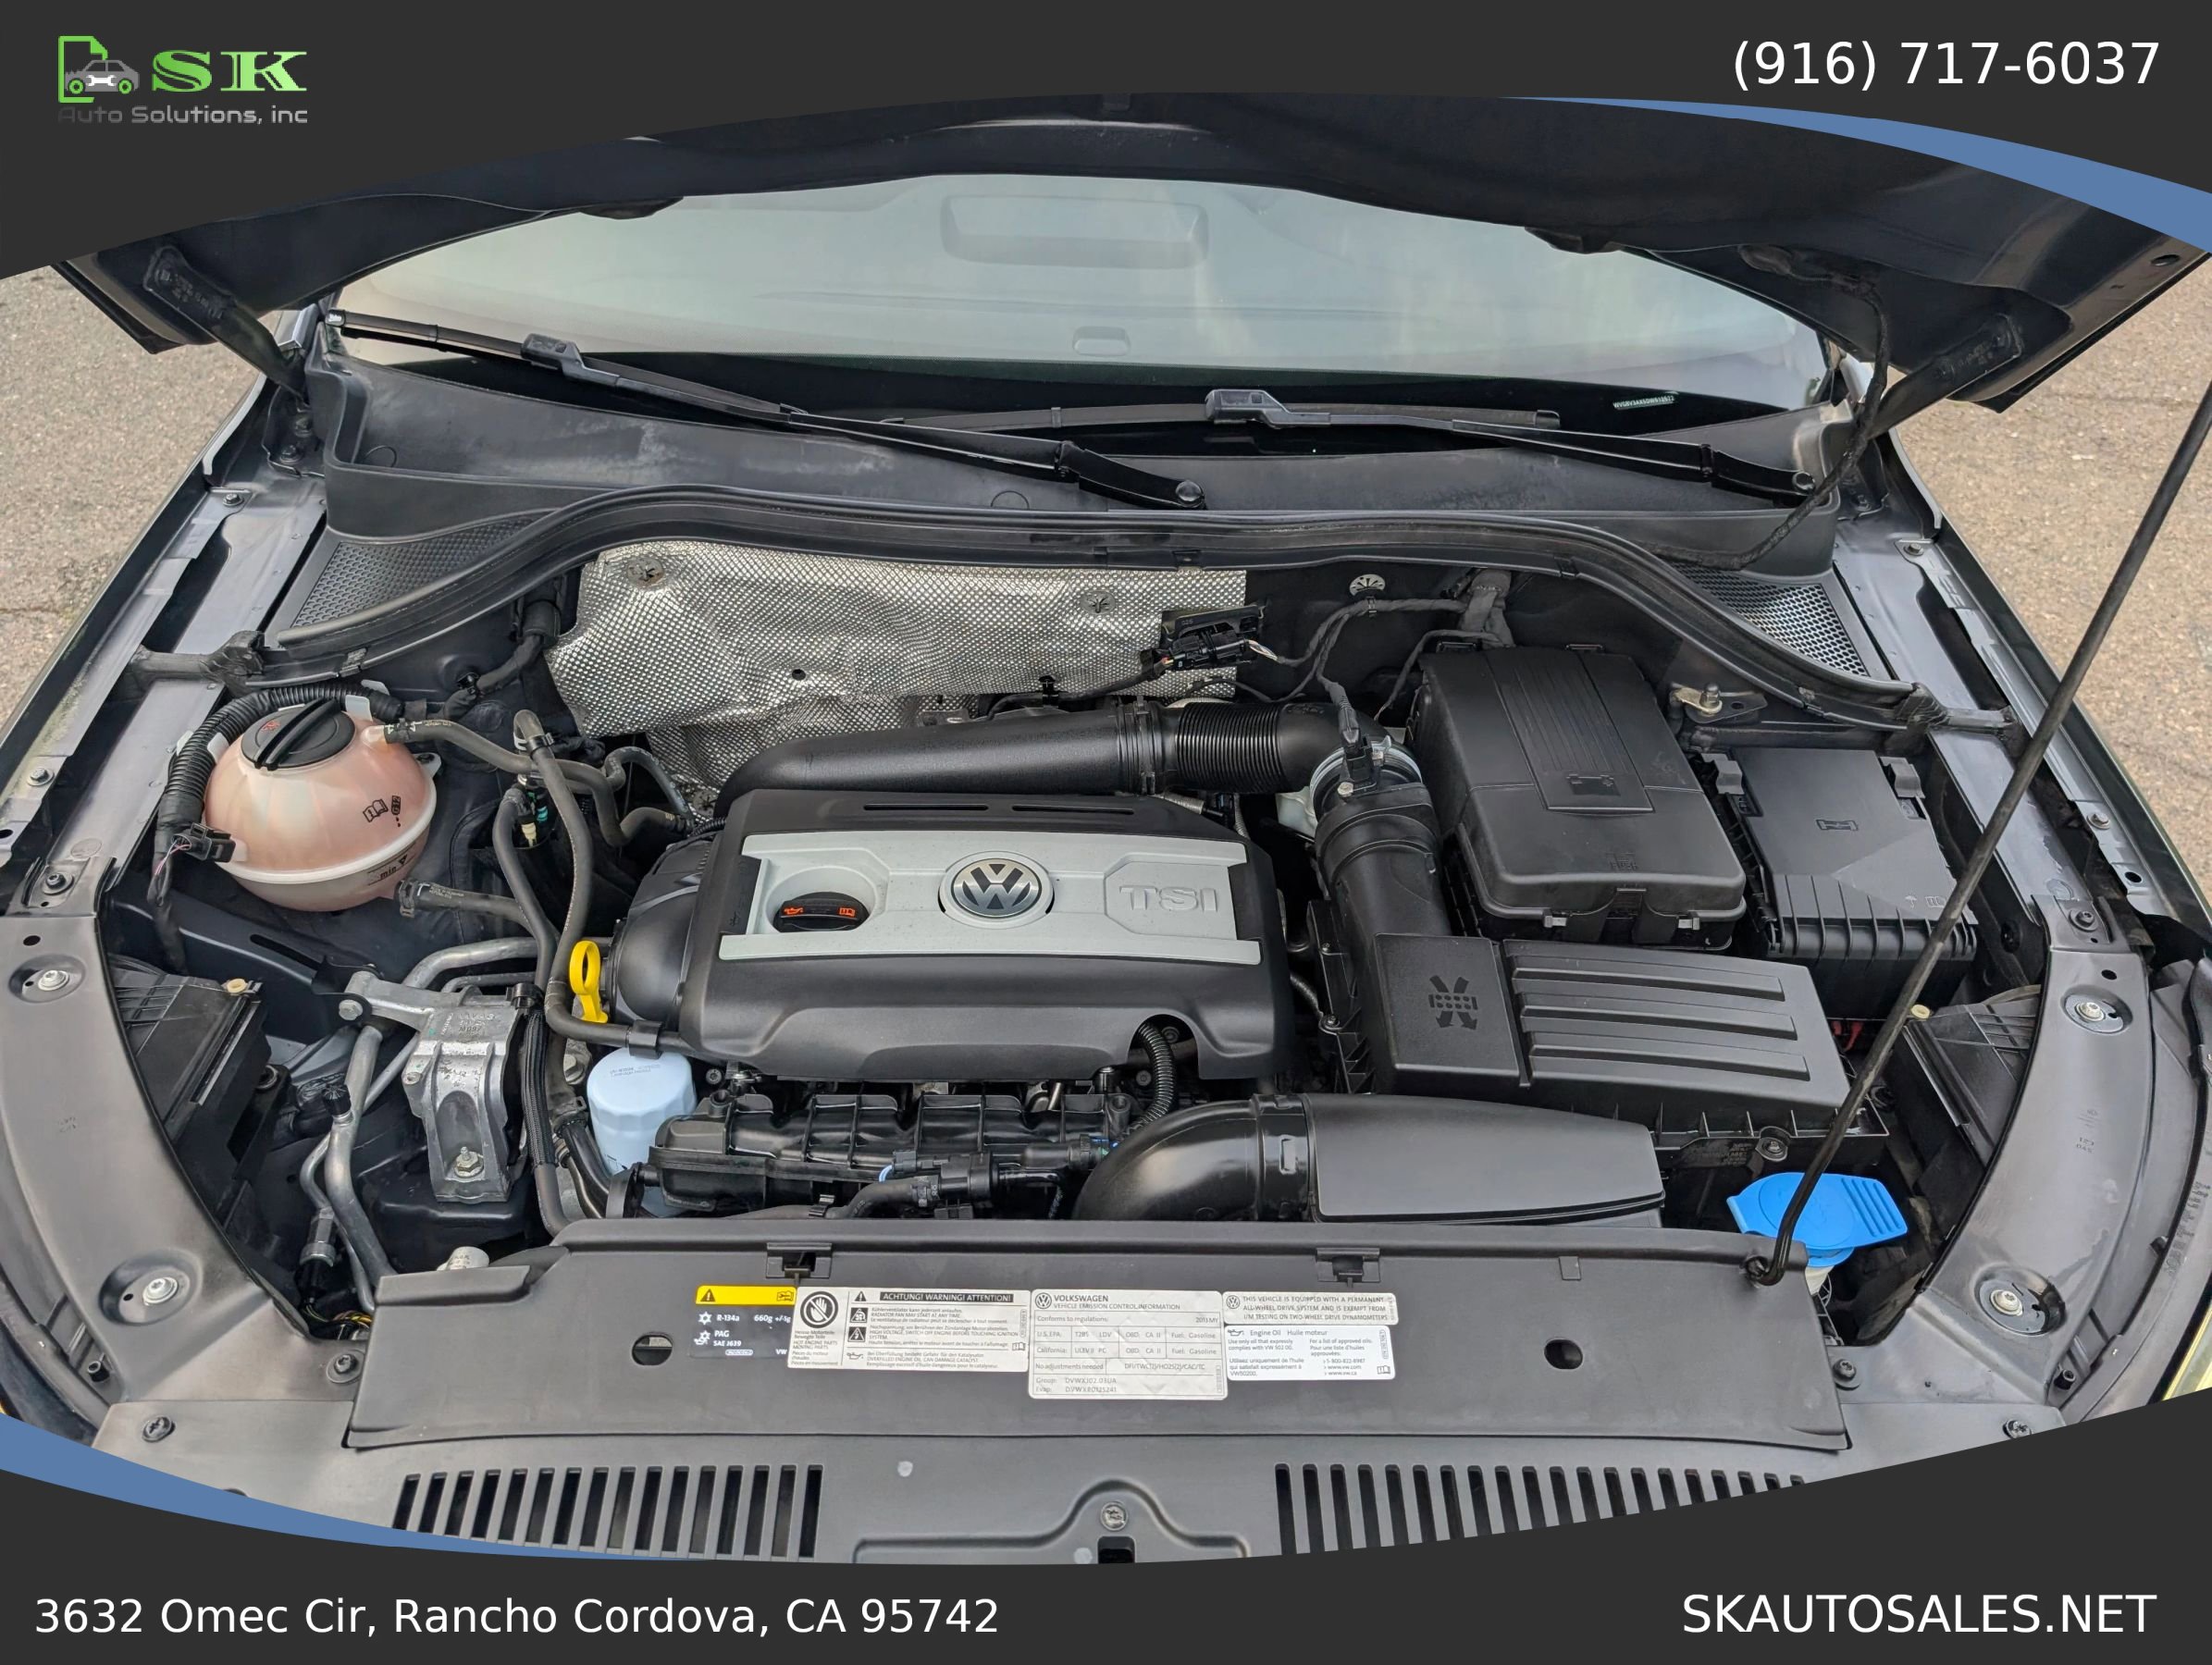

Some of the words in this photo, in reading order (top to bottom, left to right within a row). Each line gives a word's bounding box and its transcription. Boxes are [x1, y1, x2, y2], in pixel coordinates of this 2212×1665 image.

[380, 866, 397, 881] min
[1119, 885, 1218, 911] TSI
[754, 1314, 772, 1323] 660g
